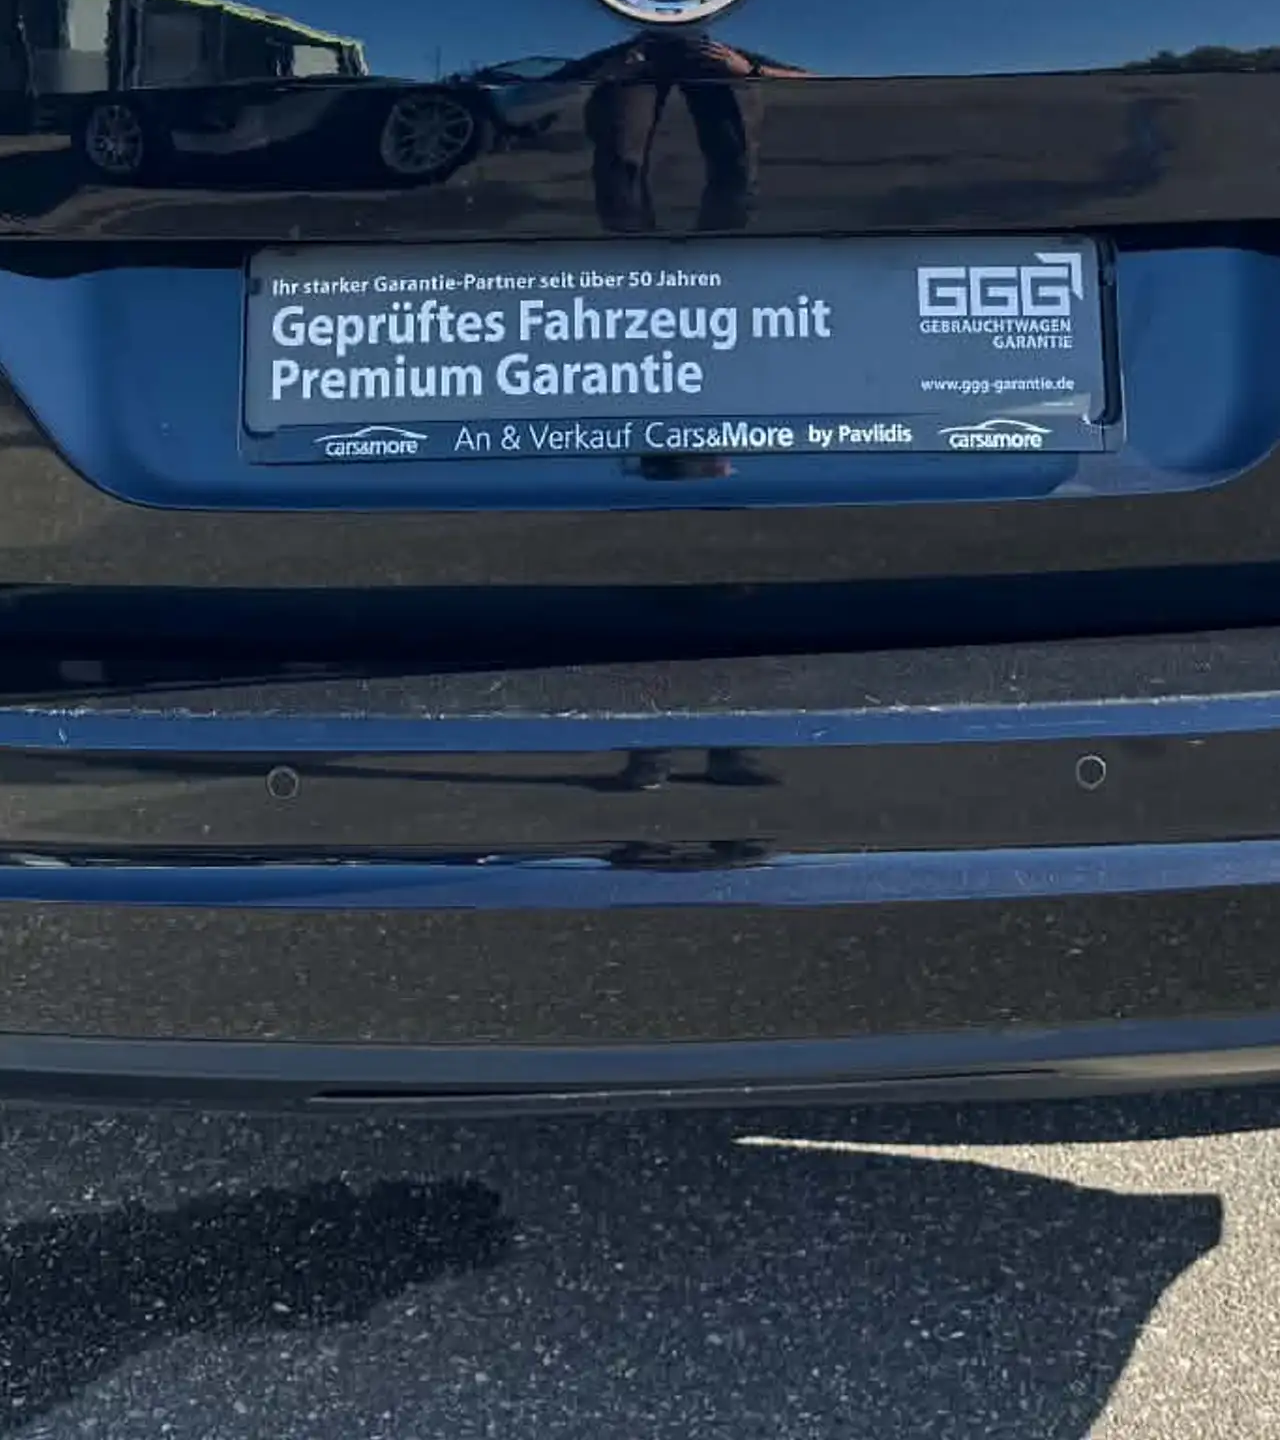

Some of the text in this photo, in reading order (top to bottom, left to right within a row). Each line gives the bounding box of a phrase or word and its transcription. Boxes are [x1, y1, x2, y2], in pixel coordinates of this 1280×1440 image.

[272, 270, 722, 296] Ihr starker Garantie-Partner seit über 50 Jahren
[917, 266, 1071, 317] GGG
[272, 295, 832, 358] Geprüftes Fahrzeug mit
[919, 318, 1072, 334] GEBRAUCHTWAGEN
[992, 334, 1074, 350] GARANTIE
[271, 350, 705, 401] Premium Garantie
[920, 375, 1076, 395] www.ggg-garantie.de
[453, 421, 913, 452] An & Verkauf Cars&More by Pavlidis
